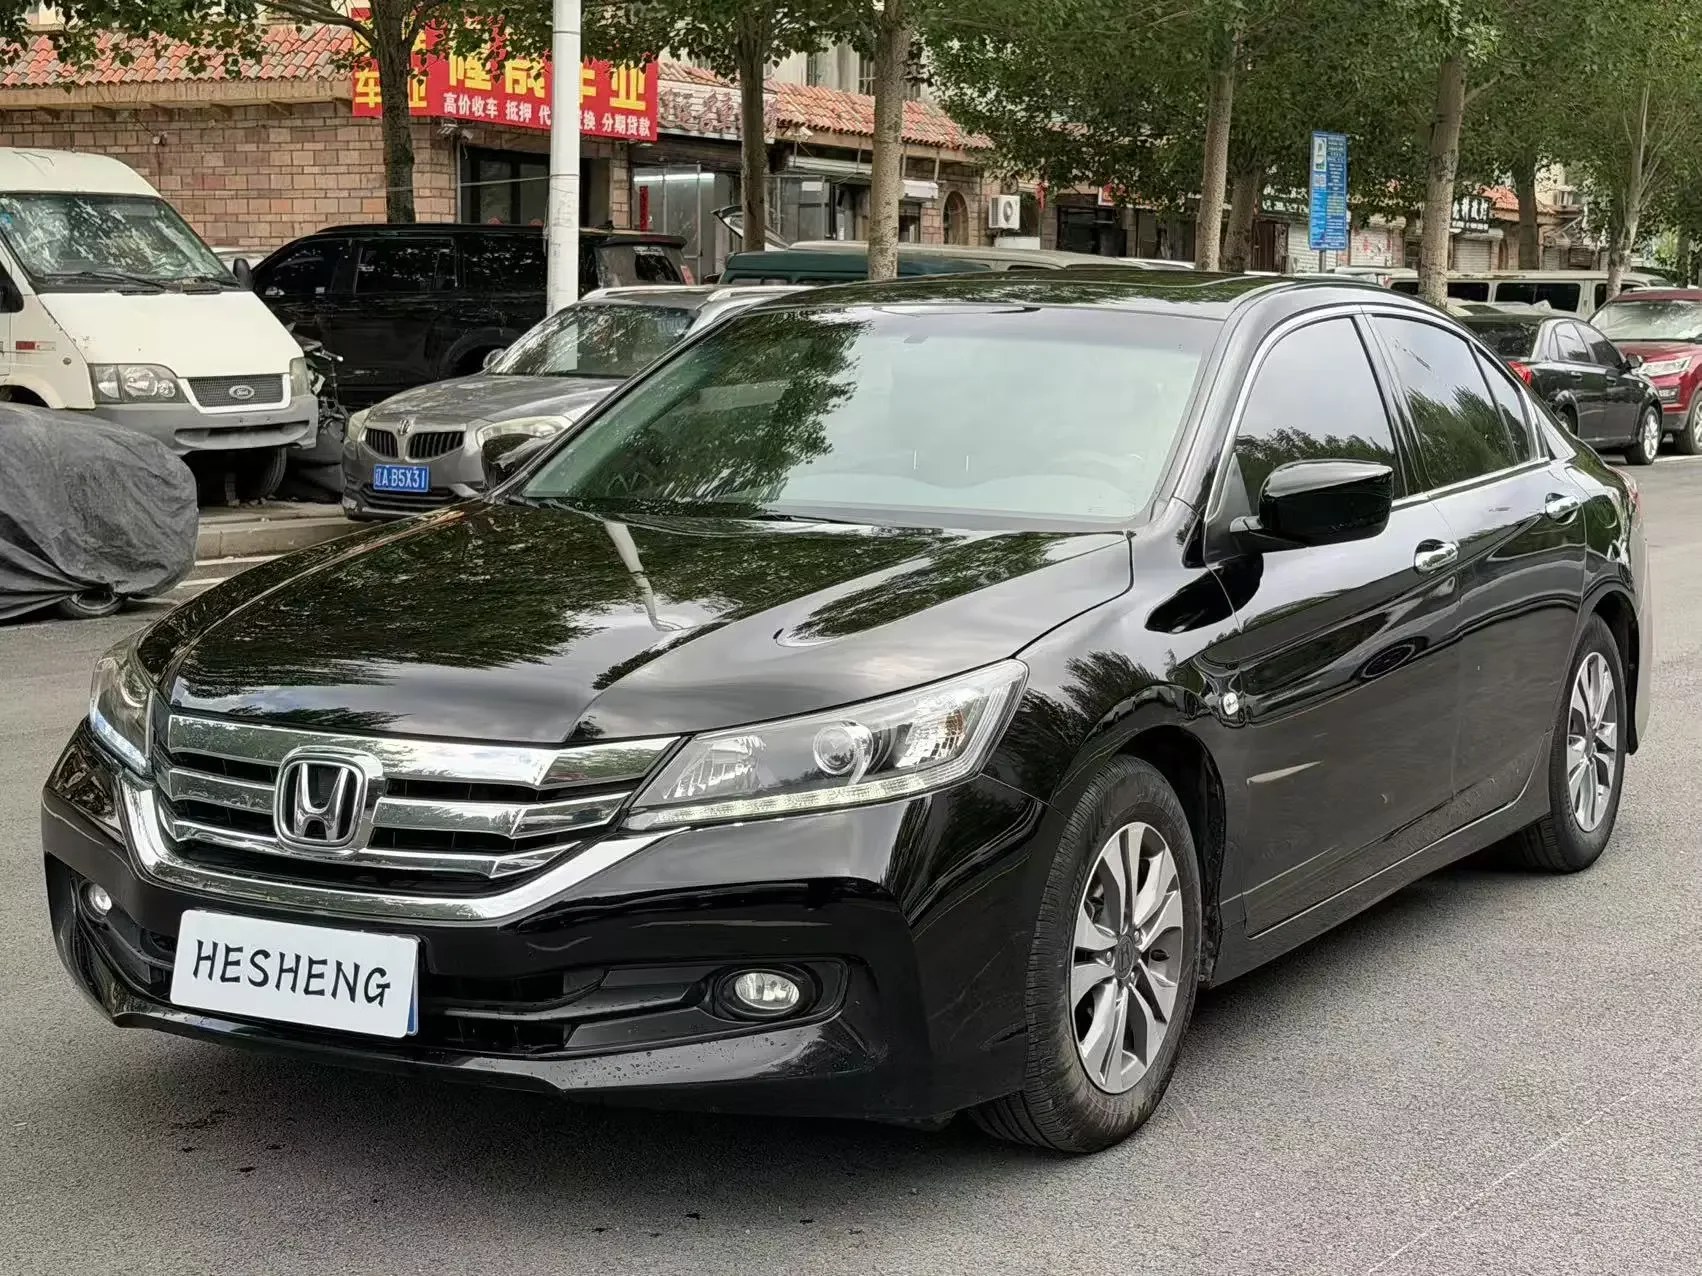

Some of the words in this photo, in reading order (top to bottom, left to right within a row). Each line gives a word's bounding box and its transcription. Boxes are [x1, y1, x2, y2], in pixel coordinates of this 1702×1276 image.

[443, 92, 498, 118] 高价收车
[505, 100, 532, 123] 抵押
[539, 104, 552, 126] 代
[579, 109, 596, 131] 换
[602, 112, 650, 137] 分期贷款
[192, 939, 391, 1008] HESHENG
